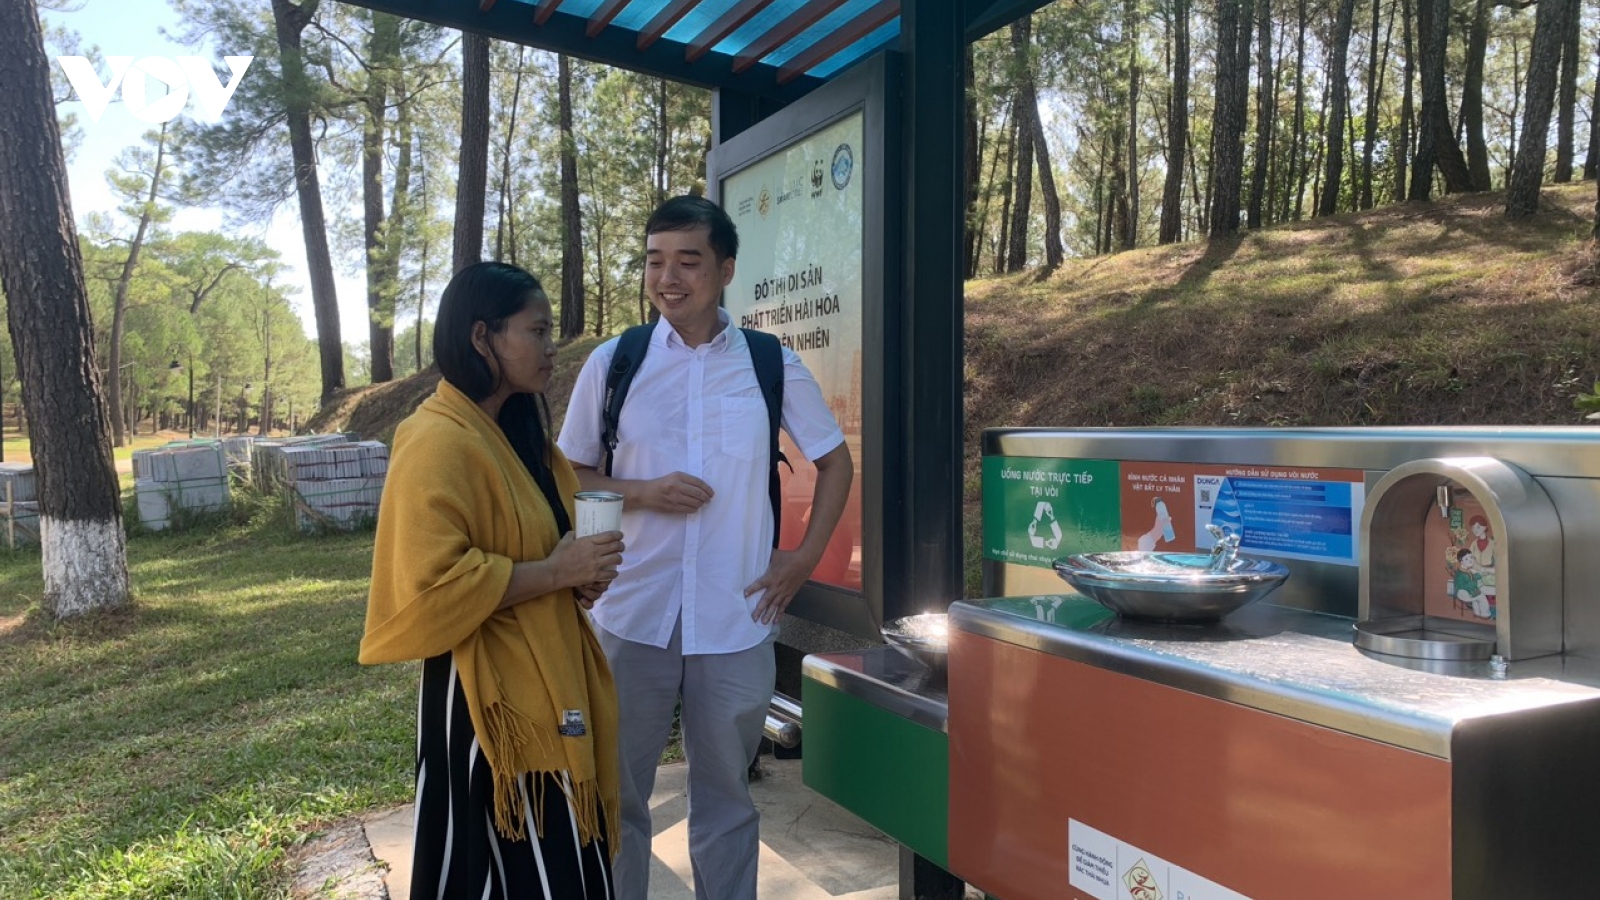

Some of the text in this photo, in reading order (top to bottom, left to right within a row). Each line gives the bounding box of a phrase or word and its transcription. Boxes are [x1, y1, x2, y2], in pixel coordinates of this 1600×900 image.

[755, 263, 823, 301] ĐÔ THỊ DI SẢN
[741, 293, 840, 330] PHÁT TRIỂN HÀI HÒA
[796, 326, 830, 352] NHIÊN
[1001, 467, 1093, 485] UỐNG NƯỚC TRỰC TIẾP
[1030, 484, 1059, 498] TẠI VÒI
